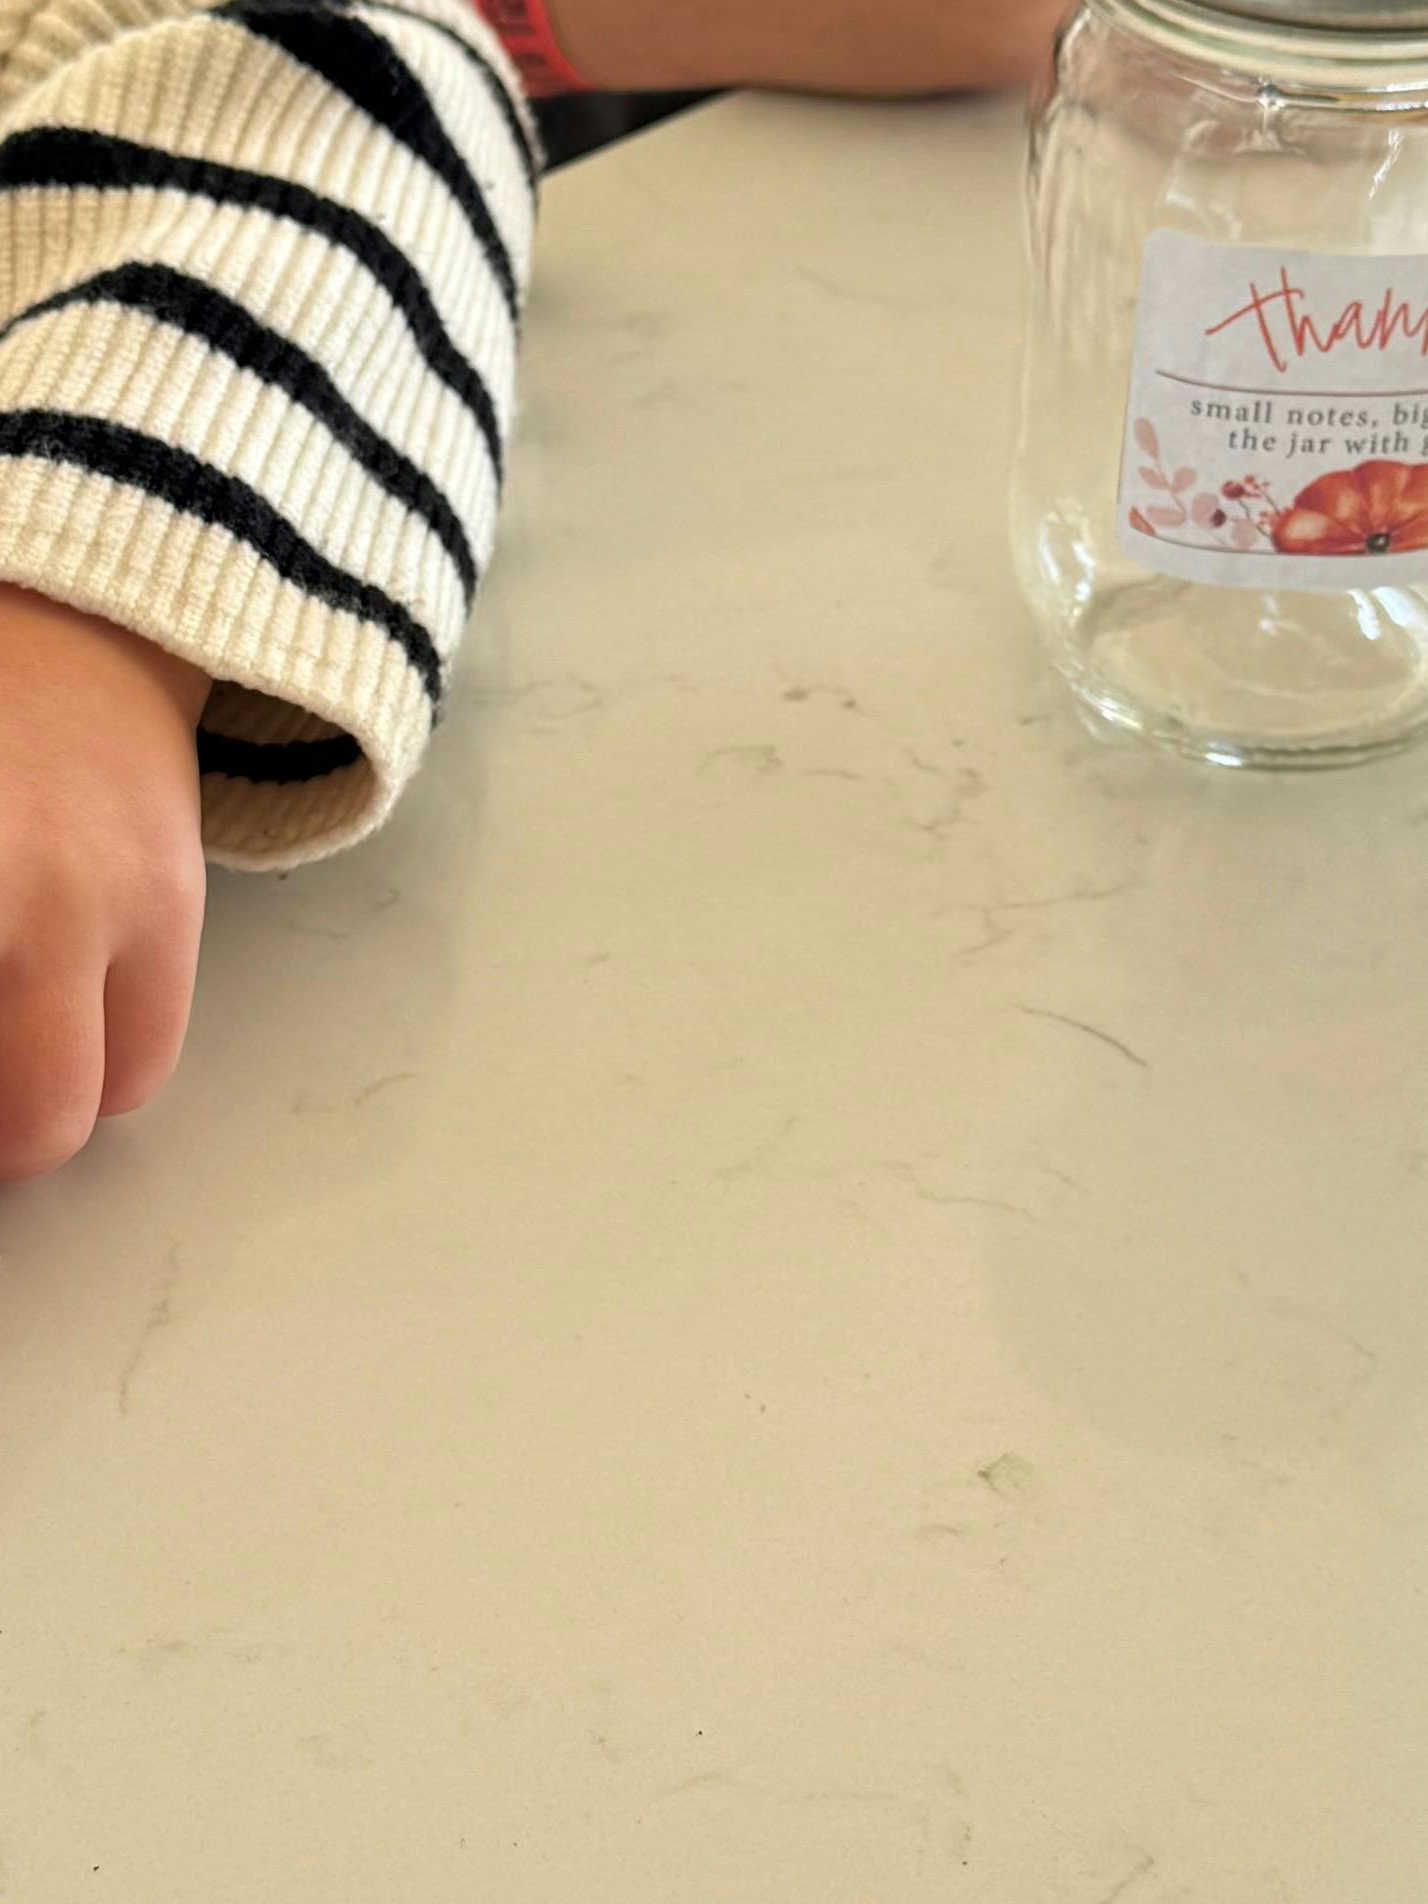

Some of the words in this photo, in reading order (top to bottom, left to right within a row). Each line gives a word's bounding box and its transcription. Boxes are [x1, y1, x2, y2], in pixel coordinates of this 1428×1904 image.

[1190, 399, 1272, 424] small
[1228, 428, 1277, 453] the
[1286, 432, 1331, 459] jar
[1343, 430, 1410, 455] with
